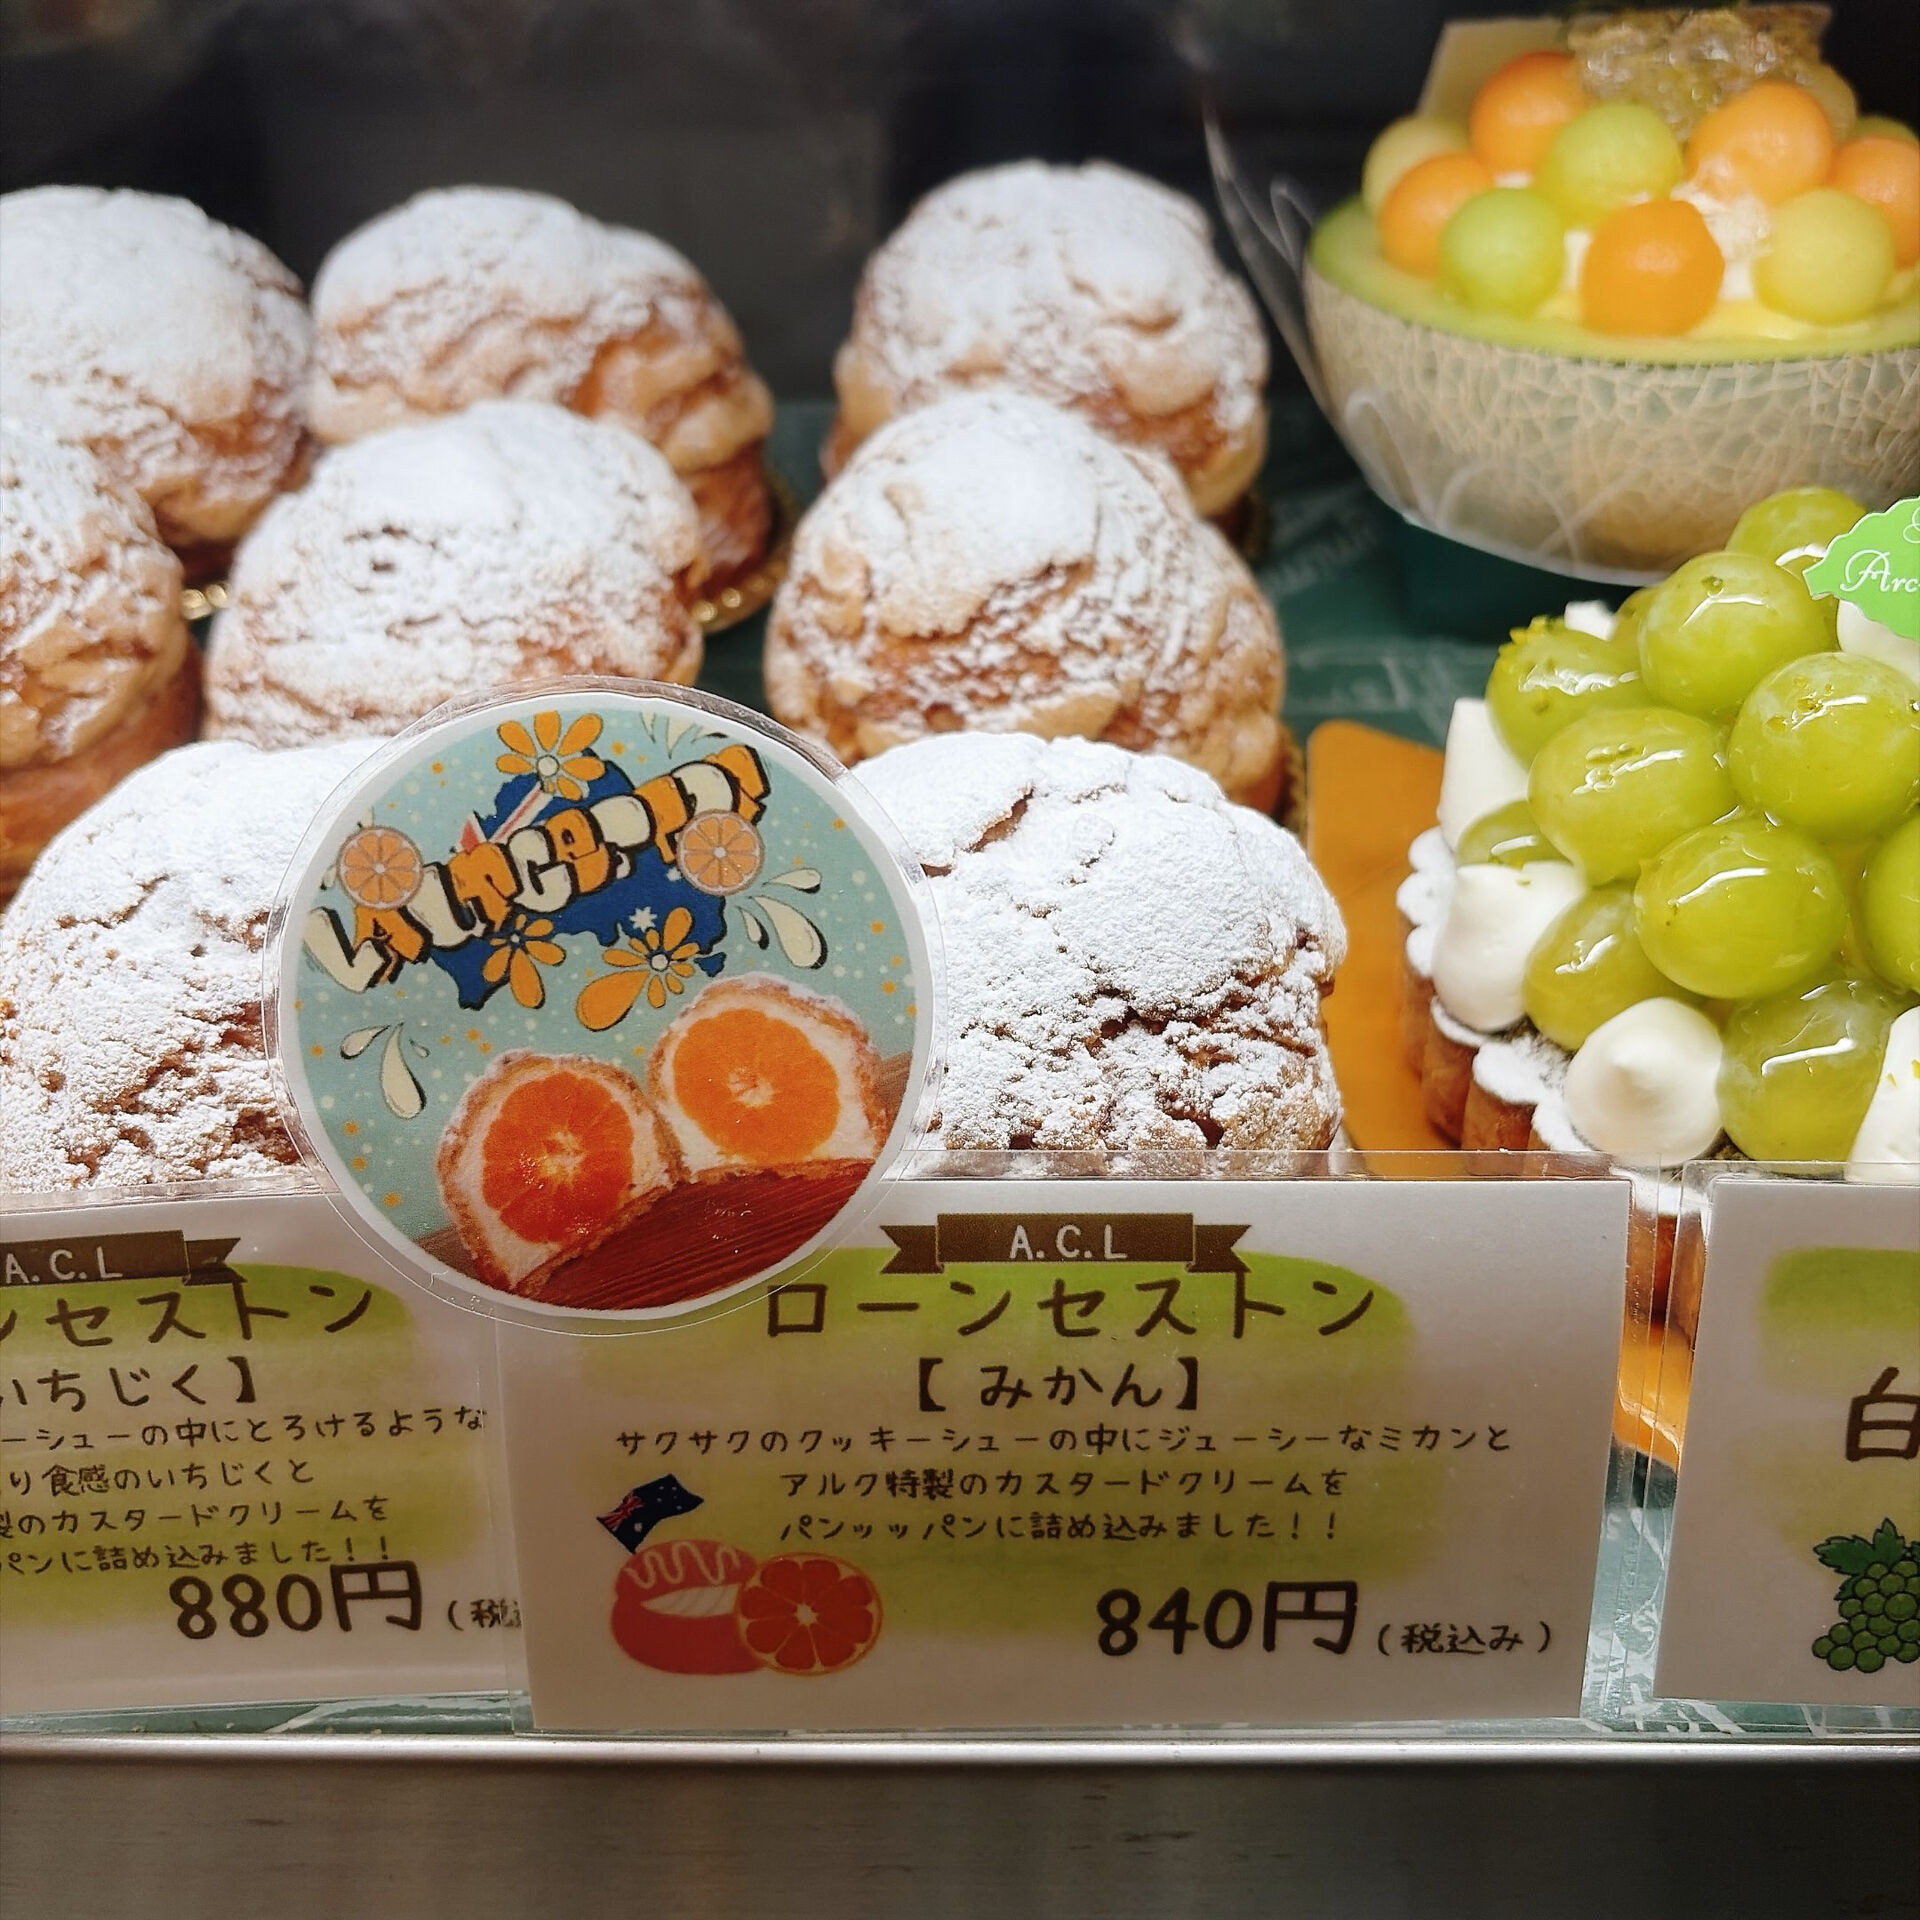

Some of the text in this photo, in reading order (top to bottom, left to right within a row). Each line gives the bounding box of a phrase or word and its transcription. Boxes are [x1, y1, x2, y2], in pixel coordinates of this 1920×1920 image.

[1839, 549, 1920, 593] Arc
[4, 1245, 124, 1285] A.C.L
[1009, 1223, 1129, 1260] A.C.L
[767, 1269, 1375, 1340] ローンセストン
[1845, 1365, 1920, 1463] 白
[780, 1468, 1348, 1501] アルク特製のカスタードクリームを
[168, 1560, 423, 1640] 880円
[1097, 1580, 1359, 1656] 840円
